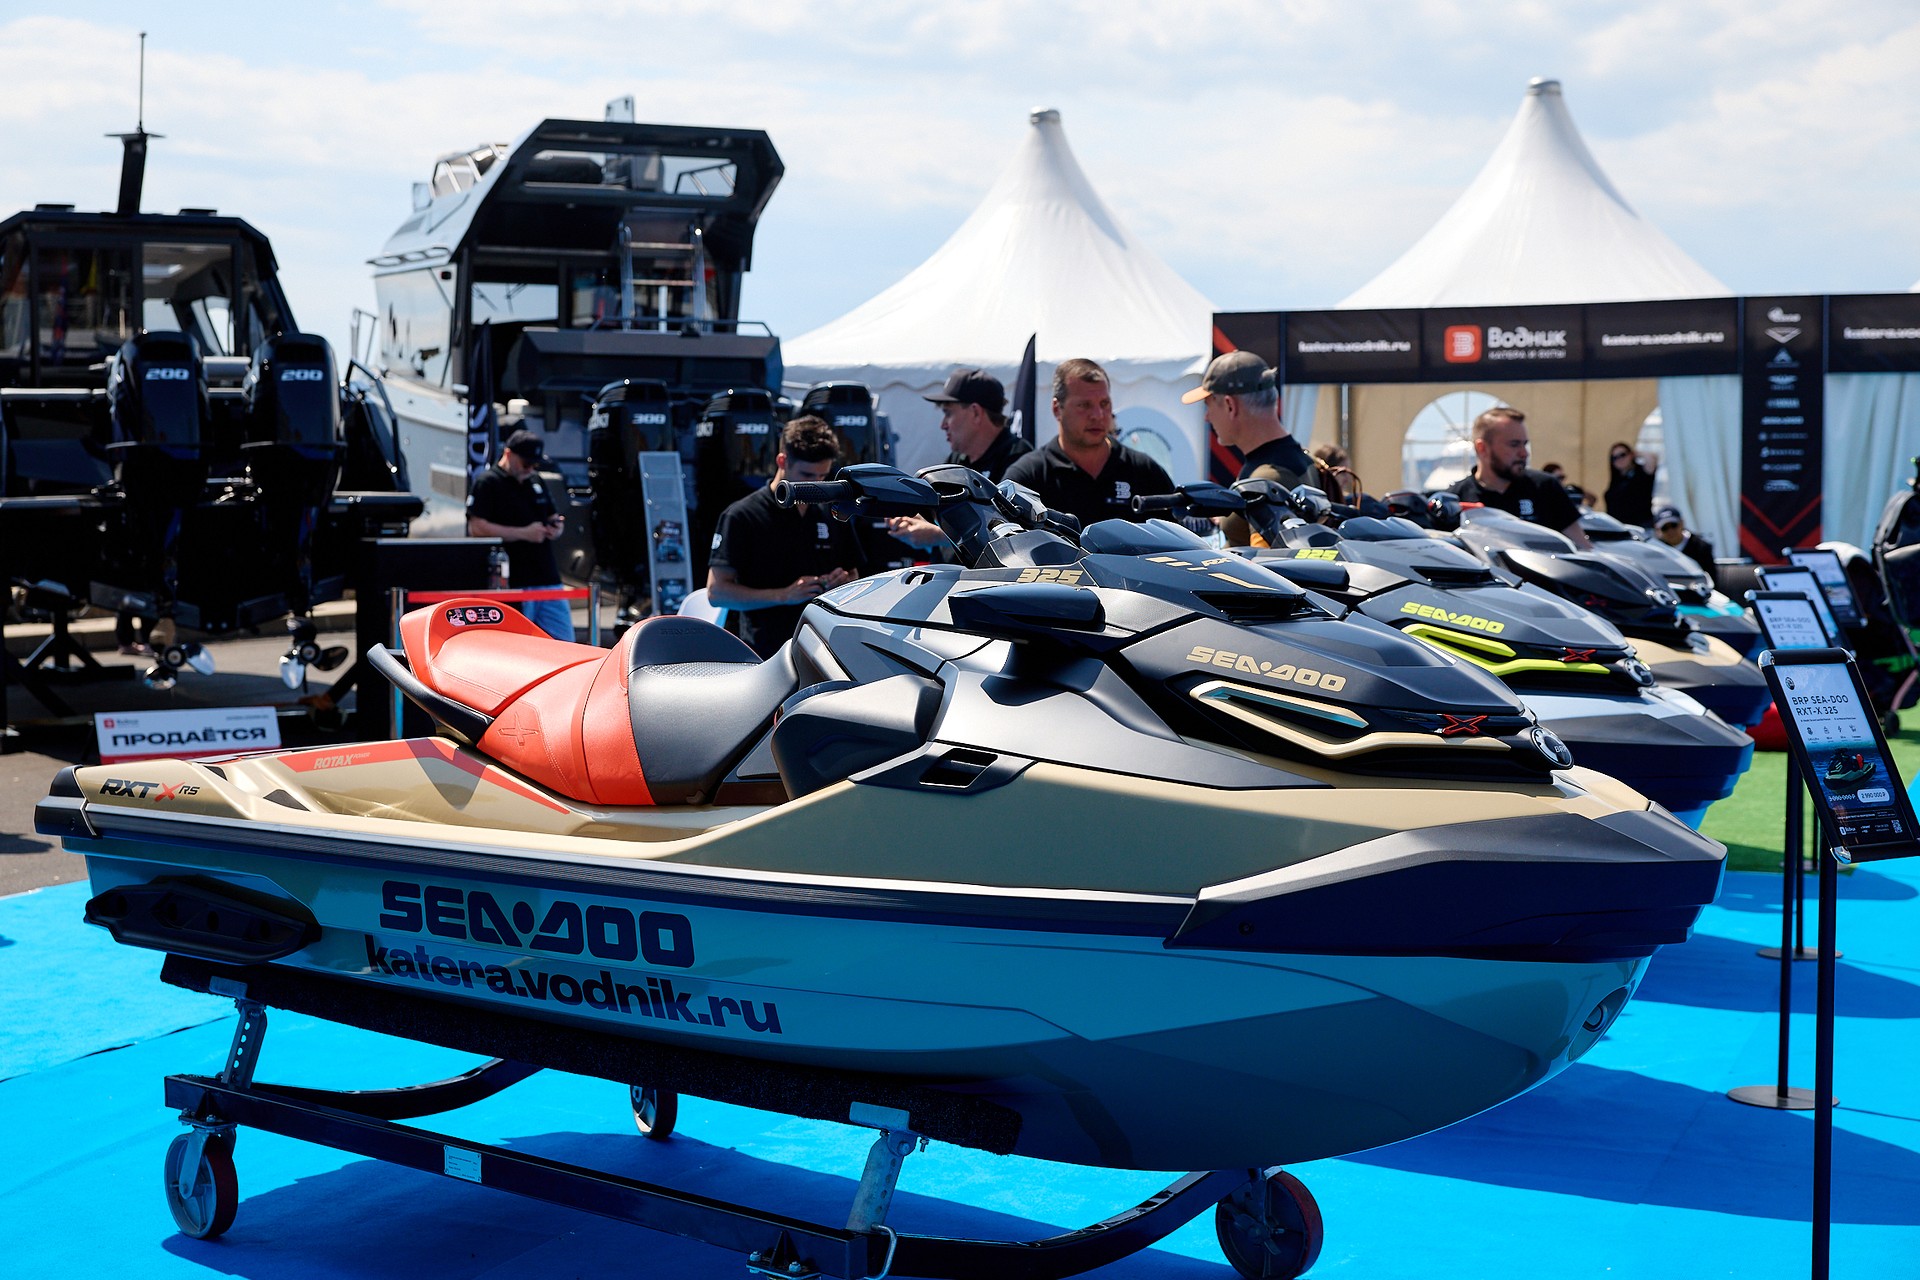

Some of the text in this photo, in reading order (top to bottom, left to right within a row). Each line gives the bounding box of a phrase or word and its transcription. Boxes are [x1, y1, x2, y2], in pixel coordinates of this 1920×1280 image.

[1602, 331, 1725, 346] katera.vodnik.ru
[1298, 339, 1412, 353] katera.vodnik.ru
[145, 367, 190, 381] 200
[281, 369, 324, 382] 200
[632, 413, 667, 425] 300
[833, 415, 868, 426] 300
[734, 422, 769, 434] 300
[1294, 549, 1339, 561] 325
[1016, 568, 1084, 585] 325
[1791, 694, 1849, 706] BRP SEA-DOO
[1795, 706, 1839, 716] RXT-X 325
[111, 727, 267, 748] ПРОДАЁТСЯ
[313, 754, 353, 770] ROTAX
[99, 778, 160, 799] RXT
[178, 785, 201, 796] RS
[364, 934, 783, 1034] katera.vodnik.ru
